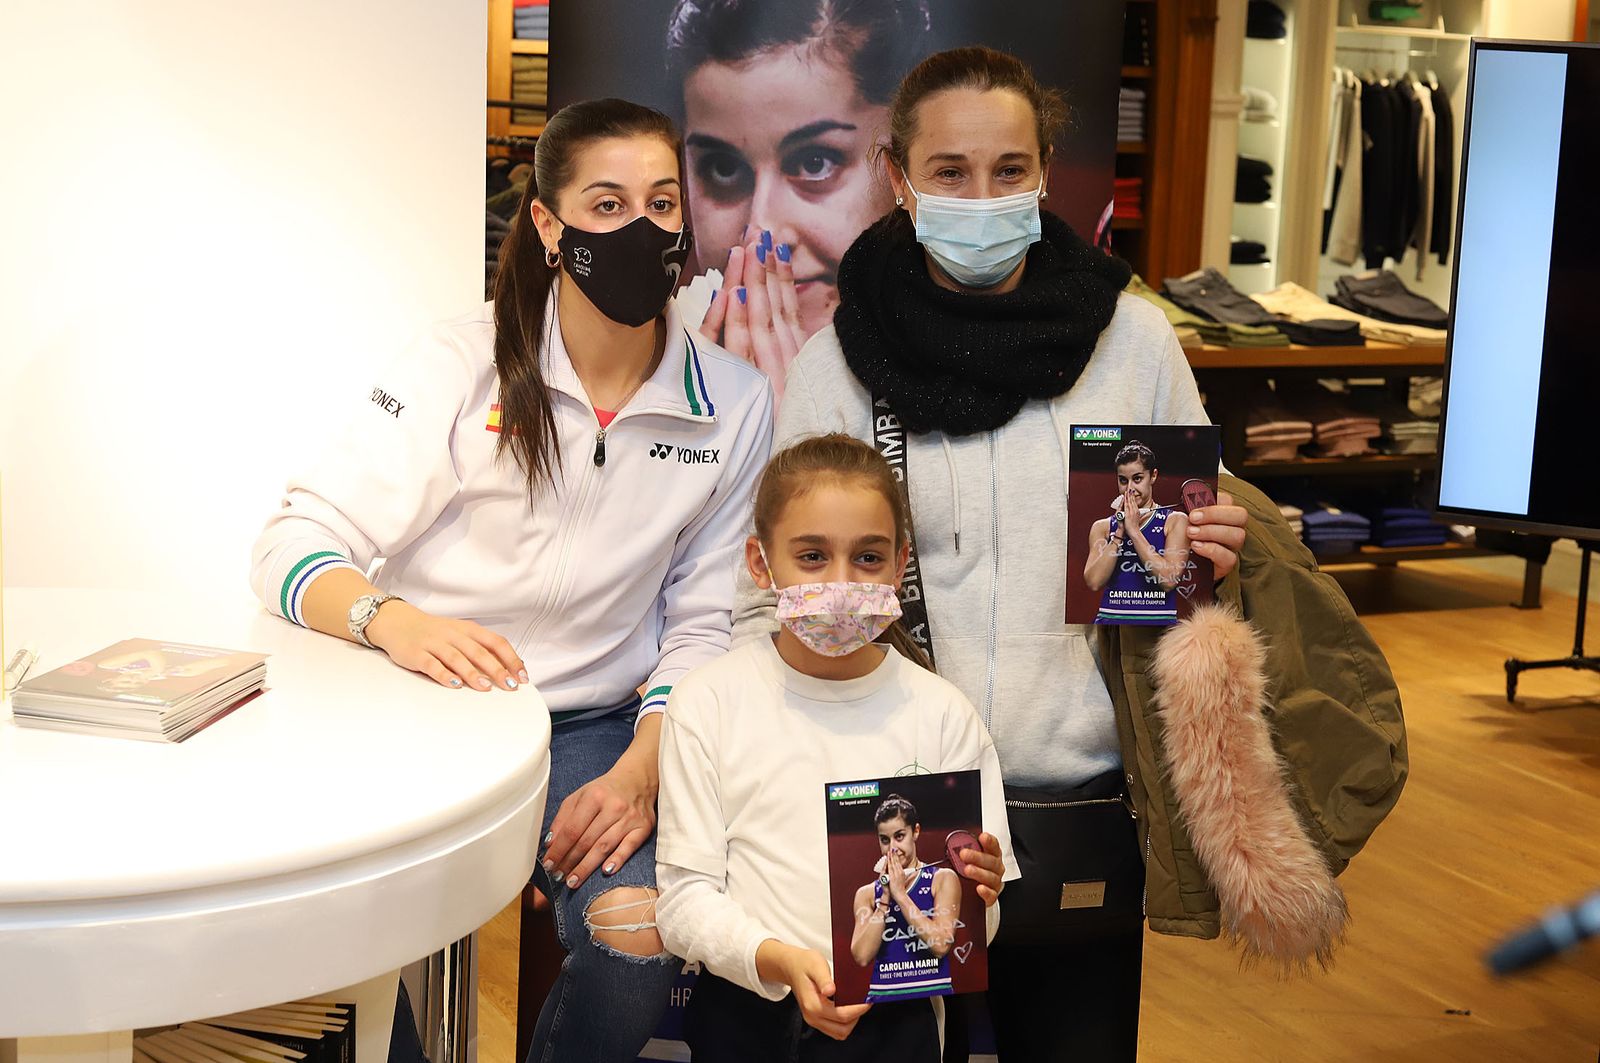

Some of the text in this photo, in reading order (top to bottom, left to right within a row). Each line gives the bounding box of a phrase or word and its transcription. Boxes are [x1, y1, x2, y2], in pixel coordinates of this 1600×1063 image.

[368, 387, 405, 418] YONEX
[1092, 429, 1118, 438] YONEX
[677, 447, 720, 464] YONEX
[1109, 590, 1166, 599] CAROLINA MARIN
[848, 784, 876, 796] YONEX
[879, 958, 939, 972] CAROLINA MARIN
